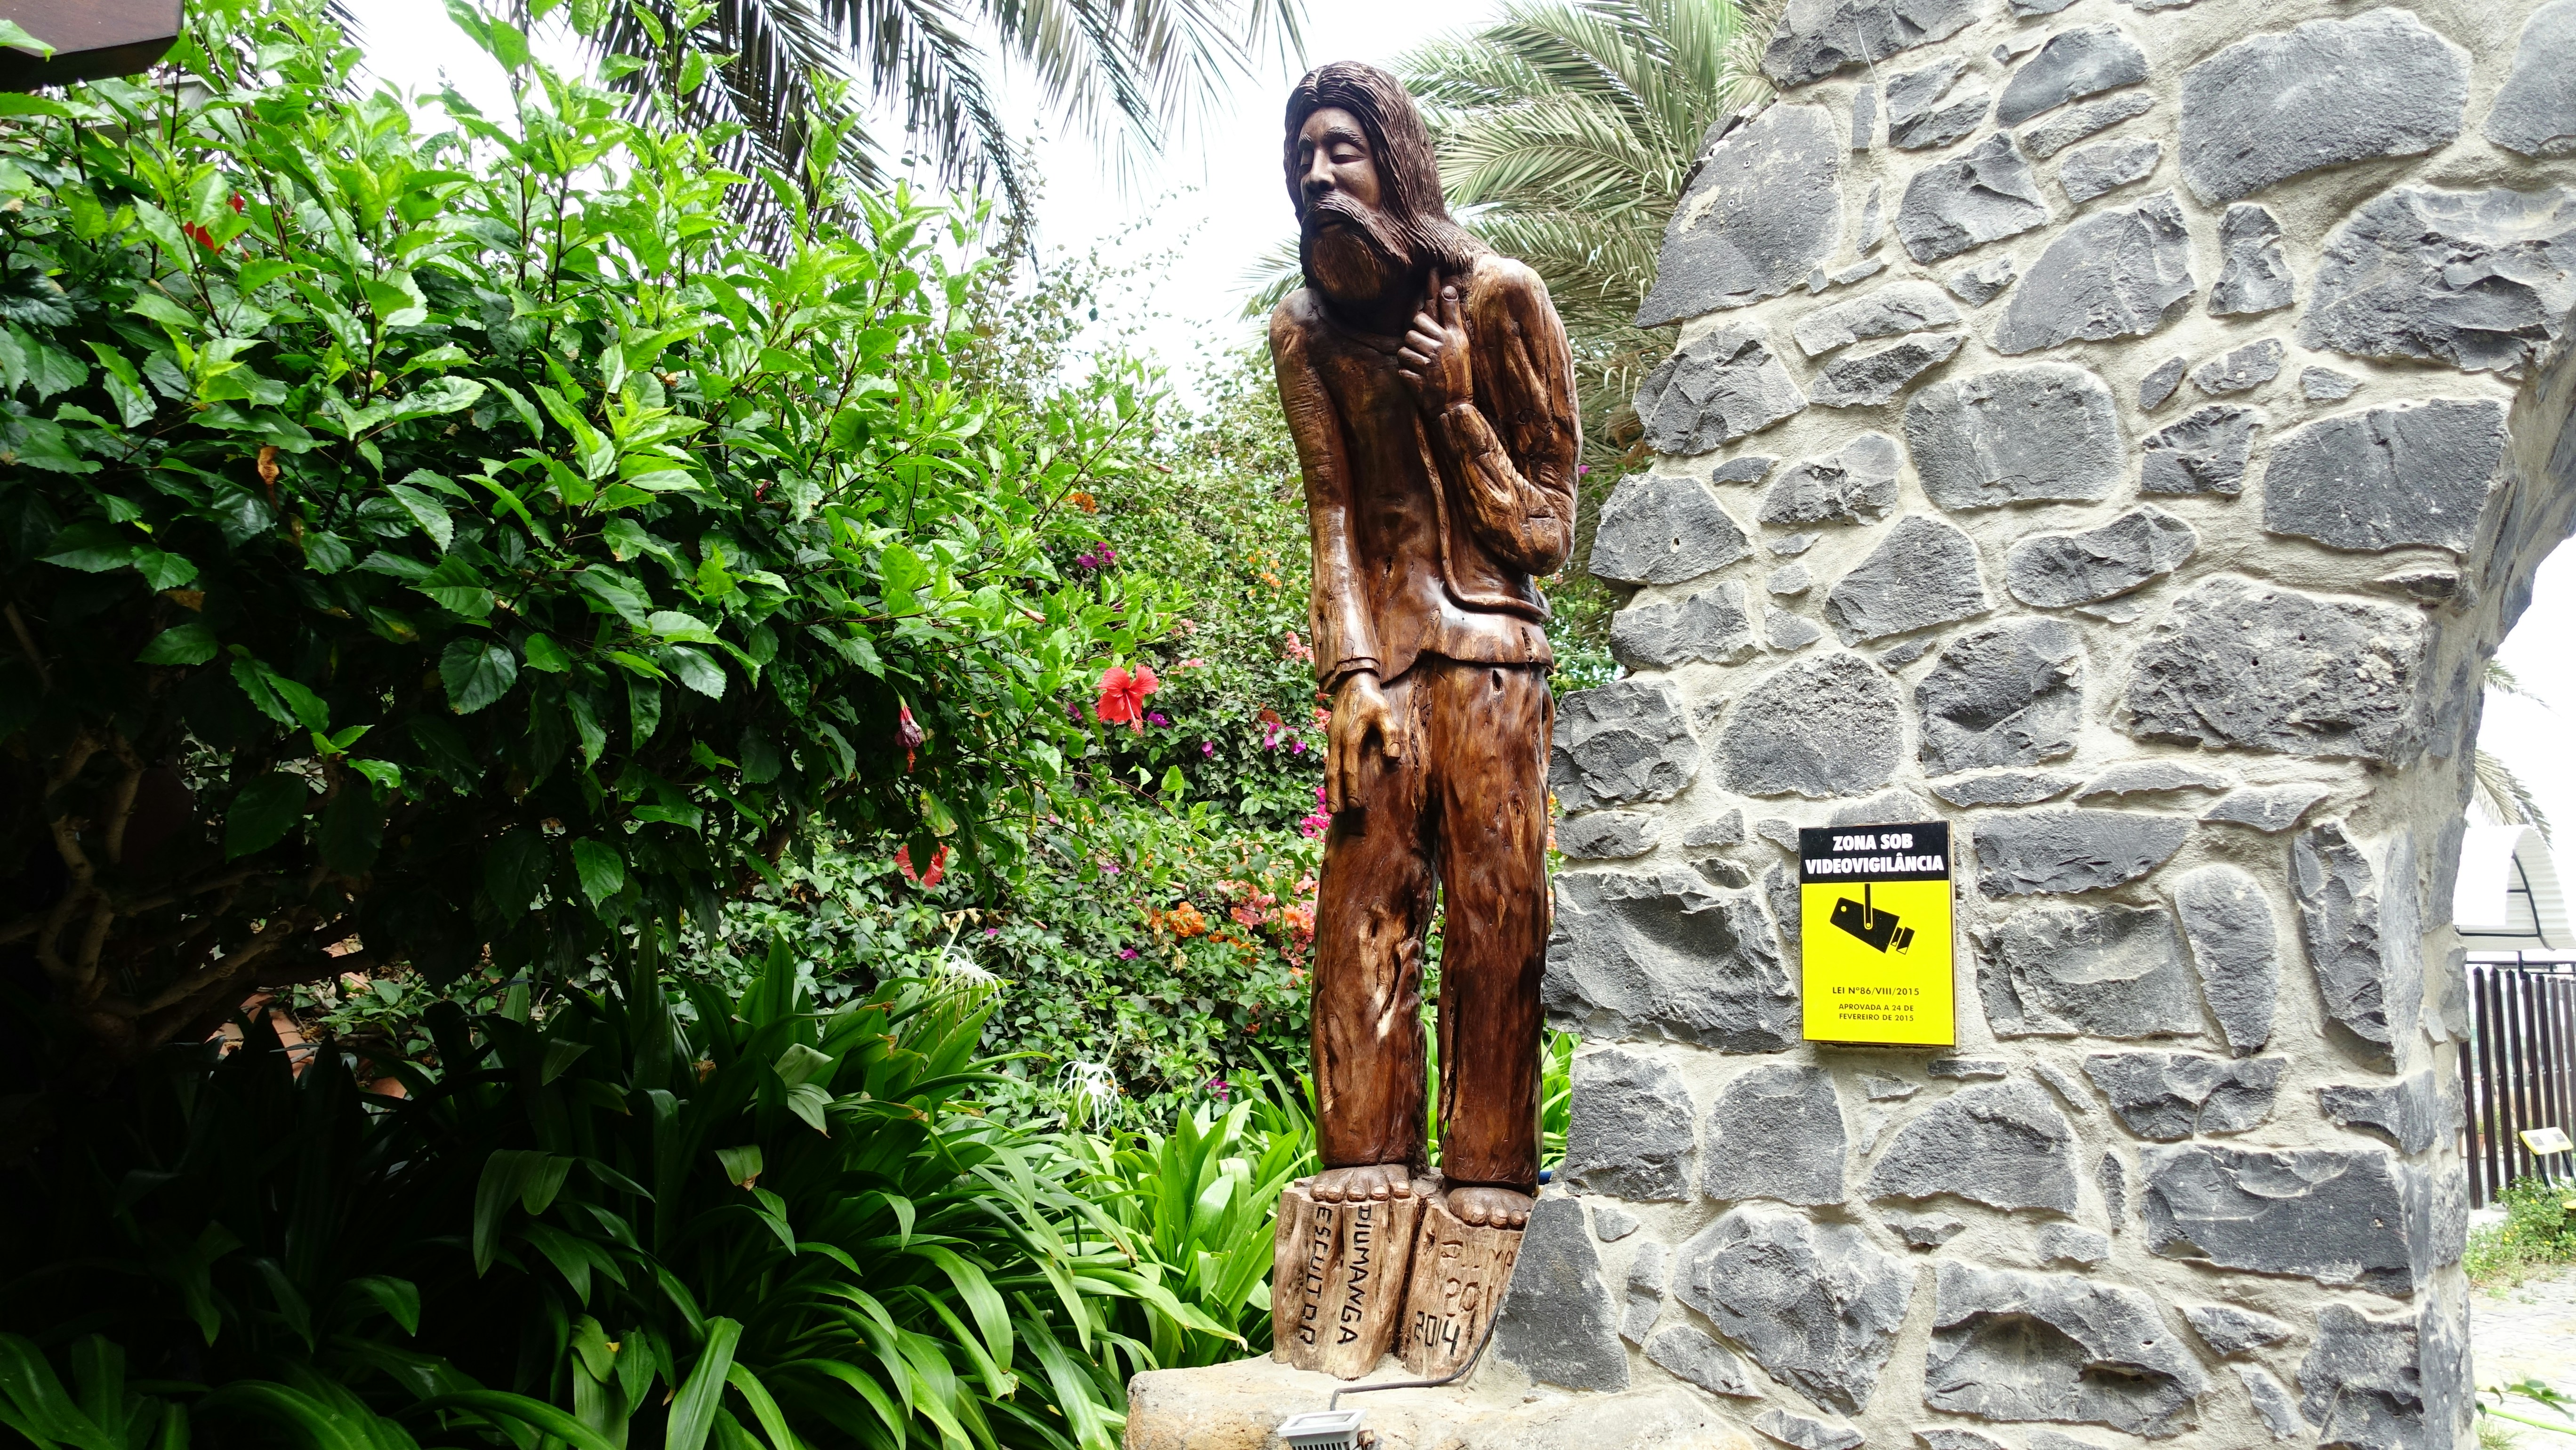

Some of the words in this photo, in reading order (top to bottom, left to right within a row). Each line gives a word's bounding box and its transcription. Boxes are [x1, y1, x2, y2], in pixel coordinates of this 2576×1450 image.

[1832, 835, 1877, 851] ZONA
[1880, 833, 1913, 850] SOB
[1805, 852, 1945, 874] VIDEOVIGILÂNCIA
[1298, 1207, 1332, 1345] ESCULTOR
[1414, 1311, 1460, 1357] 2014
